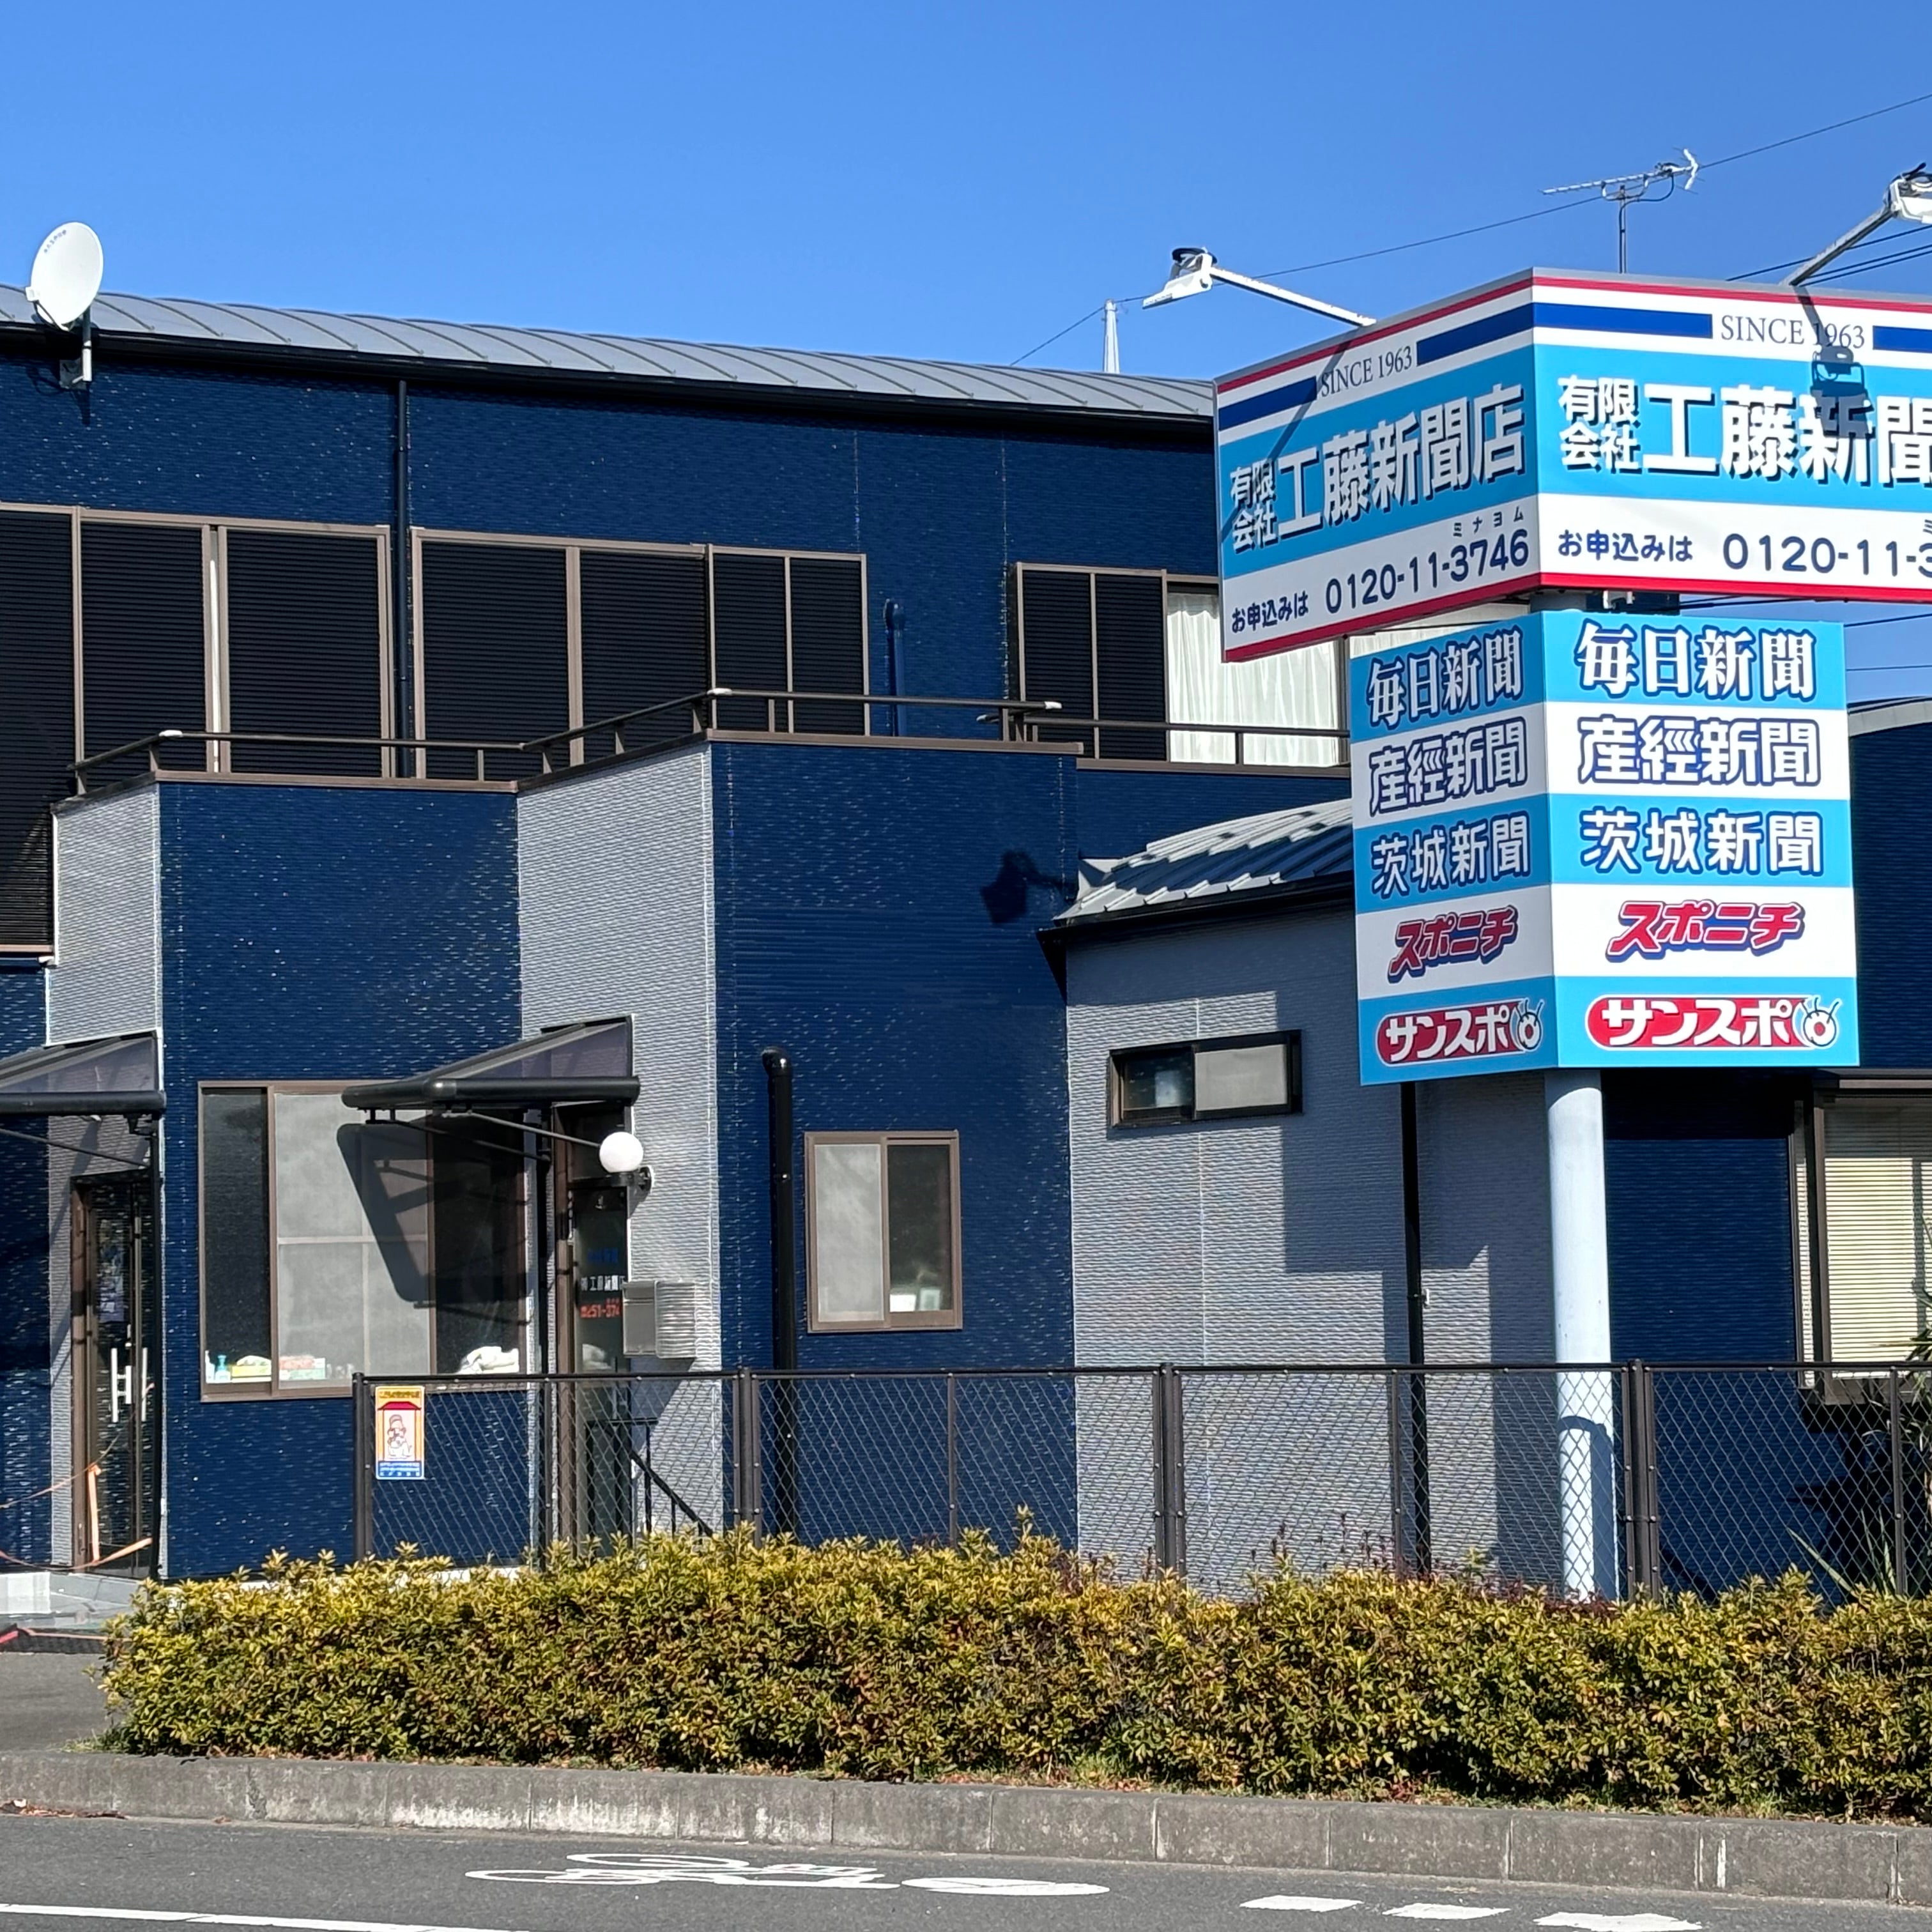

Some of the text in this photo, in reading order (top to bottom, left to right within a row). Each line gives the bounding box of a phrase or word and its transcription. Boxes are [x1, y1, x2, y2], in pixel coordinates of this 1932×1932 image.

[1721, 314, 1866, 349] SINCE 1963
[1321, 345, 1413, 397] SINCE 1963
[1558, 374, 1640, 426] 有限
[1278, 381, 1526, 539] 工藤新聞店
[1560, 422, 1641, 473] 会社
[1642, 383, 1932, 488] 工藤新聞
[1230, 459, 1276, 509] 有限
[1233, 504, 1278, 554] 会社
[1453, 506, 1524, 538] ミナヨム
[1558, 529, 1694, 563] お申込みは
[1231, 530, 1529, 634] お申込みは 0120-11-3746
[1366, 625, 1524, 728] 毎日新聞
[1574, 618, 1818, 702] 毎日新聞
[1369, 716, 1527, 817] 産經新聞
[1577, 713, 1820, 787] 産經新聞
[1371, 810, 1530, 898] 茨城新聞
[1579, 806, 1823, 878] 茨城新聞
[1388, 905, 1519, 984] スポニチ
[1606, 899, 1805, 963] スポニチ
[1386, 1004, 1511, 1062] サンスポ
[1602, 999, 1793, 1046] サンスポ
